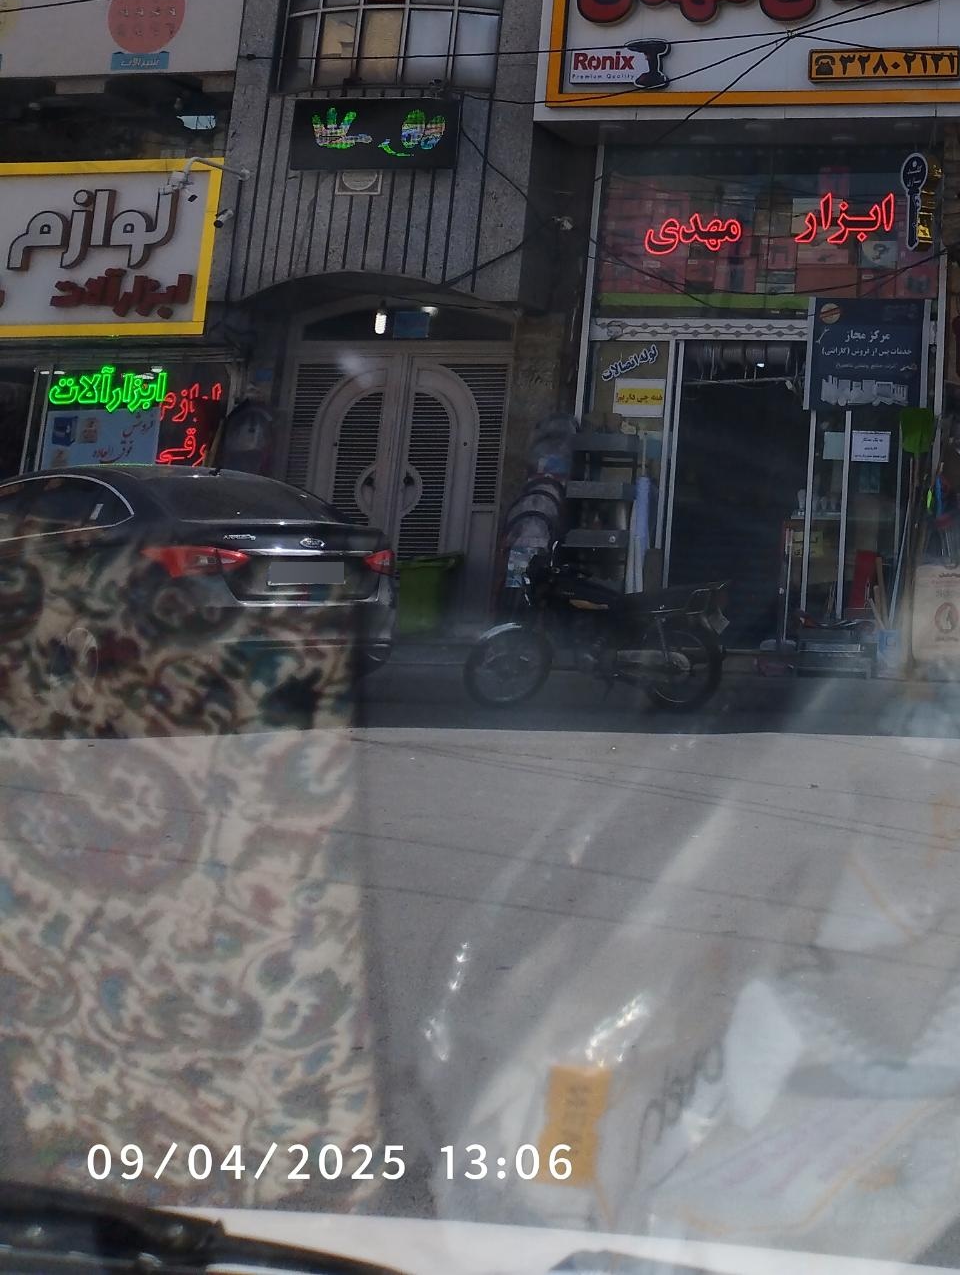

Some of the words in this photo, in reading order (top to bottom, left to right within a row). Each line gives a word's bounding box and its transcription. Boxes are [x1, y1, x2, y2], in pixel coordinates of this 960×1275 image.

[573, 52, 636, 71] Ronix
[606, 72, 635, 81] Quality
[839, 52, 956, 76] ۳۲۸۰۲۱۲۱
[7, 189, 179, 271] لوازم
[644, 212, 743, 255] مهدی
[794, 191, 897, 244] ابزار
